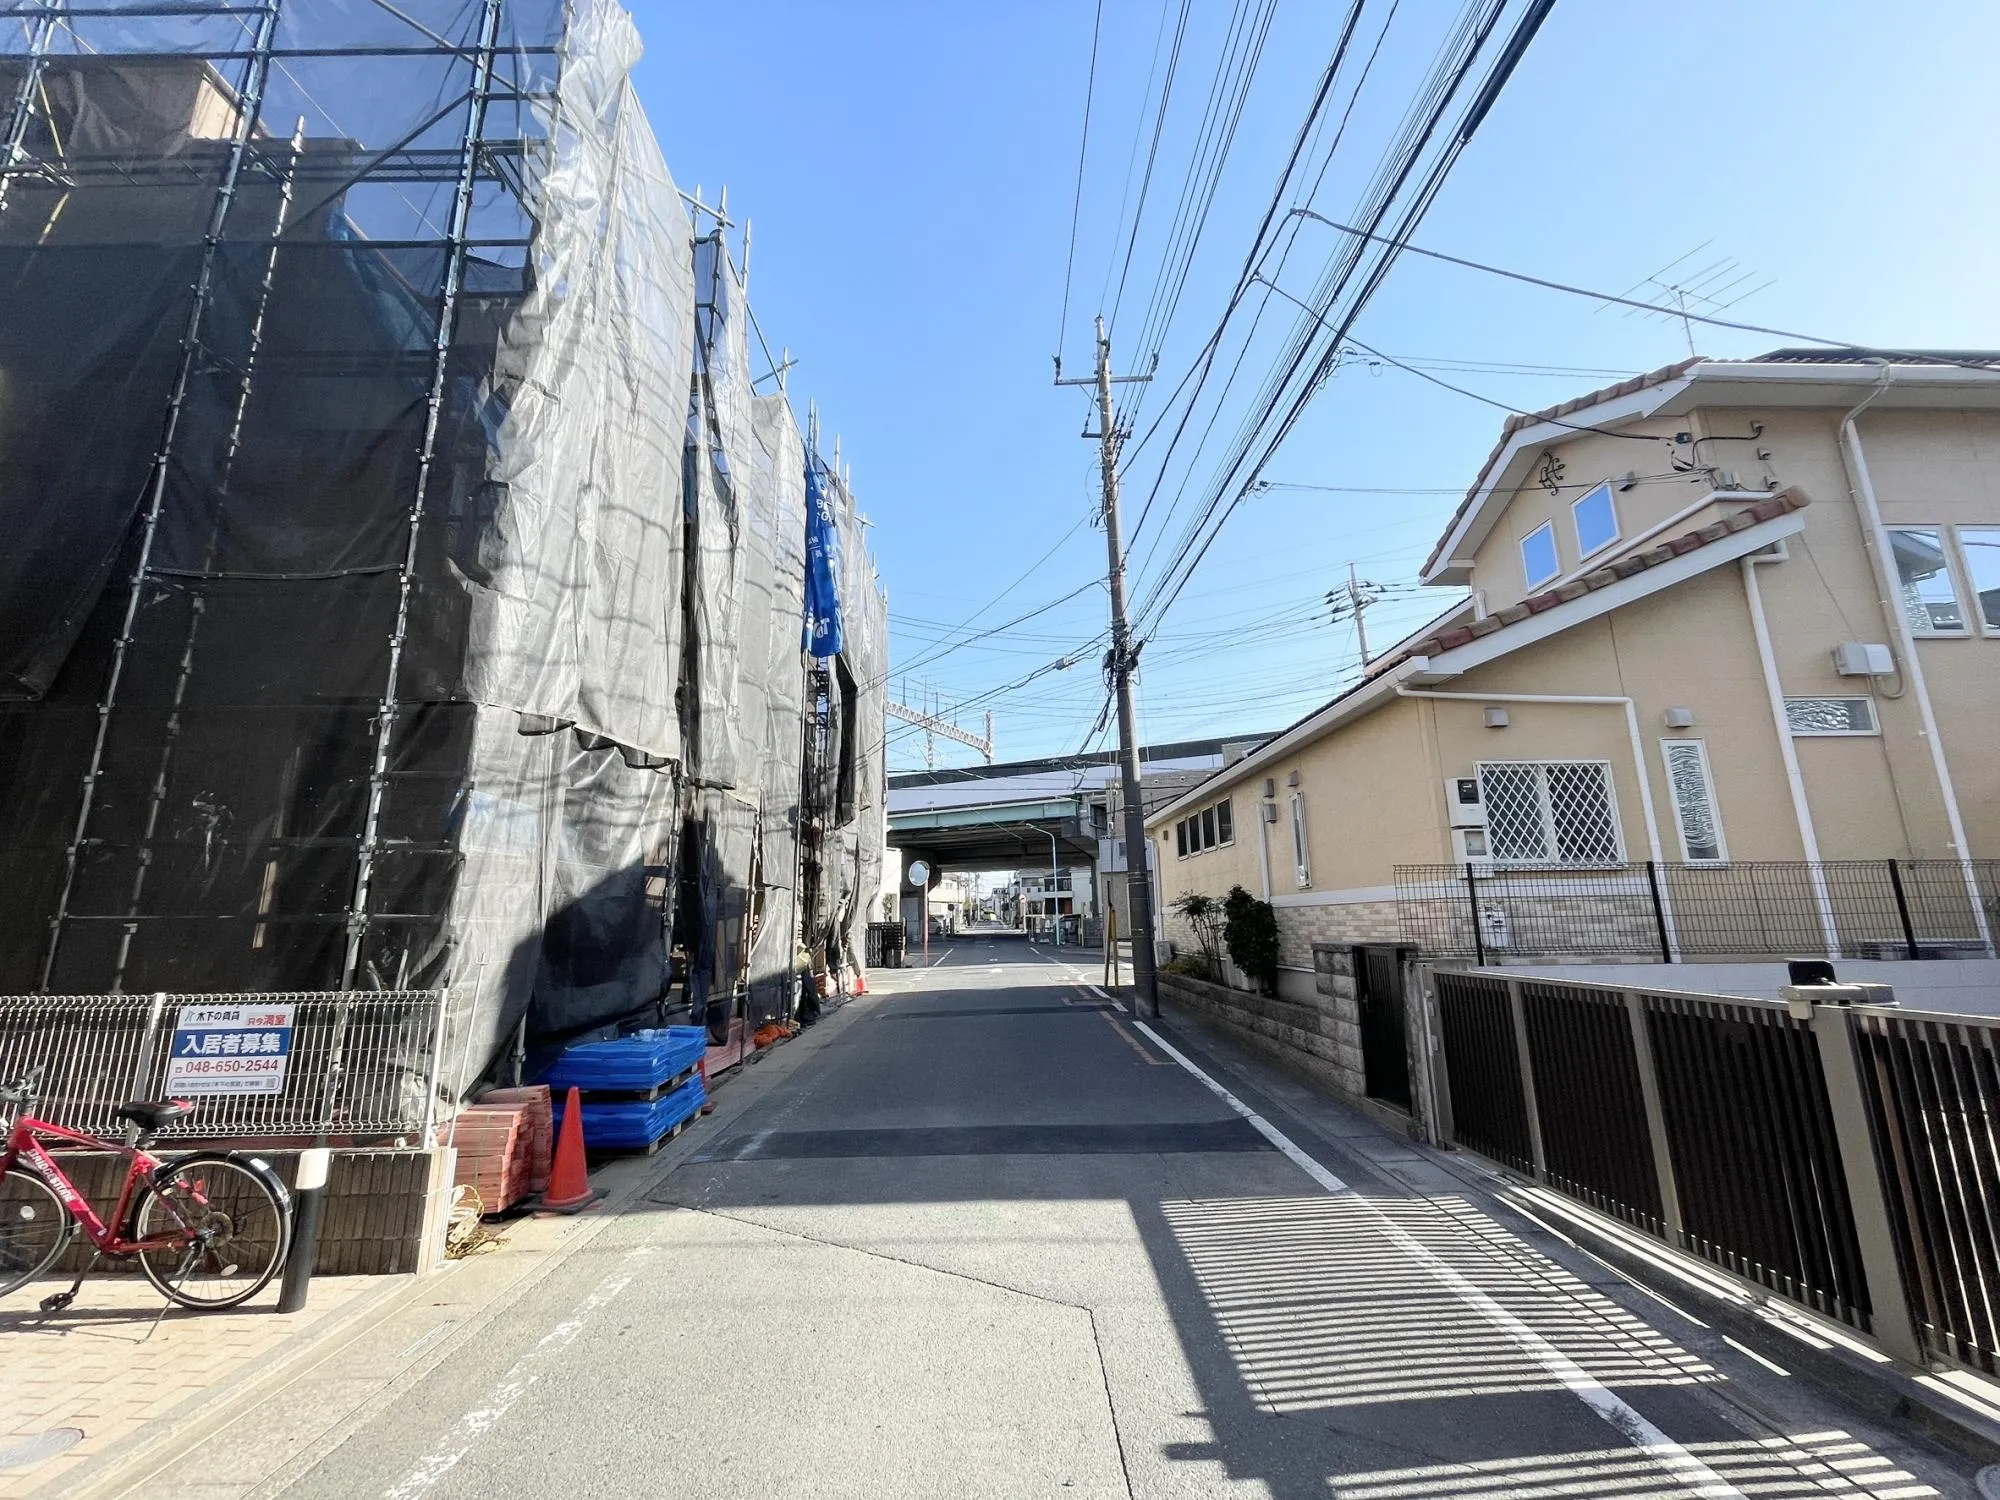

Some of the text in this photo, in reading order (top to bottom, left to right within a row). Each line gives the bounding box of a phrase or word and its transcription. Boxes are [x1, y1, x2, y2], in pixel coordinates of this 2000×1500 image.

[196, 1010, 240, 1021] 木下の賃貸
[181, 1032, 281, 1055] 入居者募集
[186, 1059, 279, 1074] 048-650-2544
